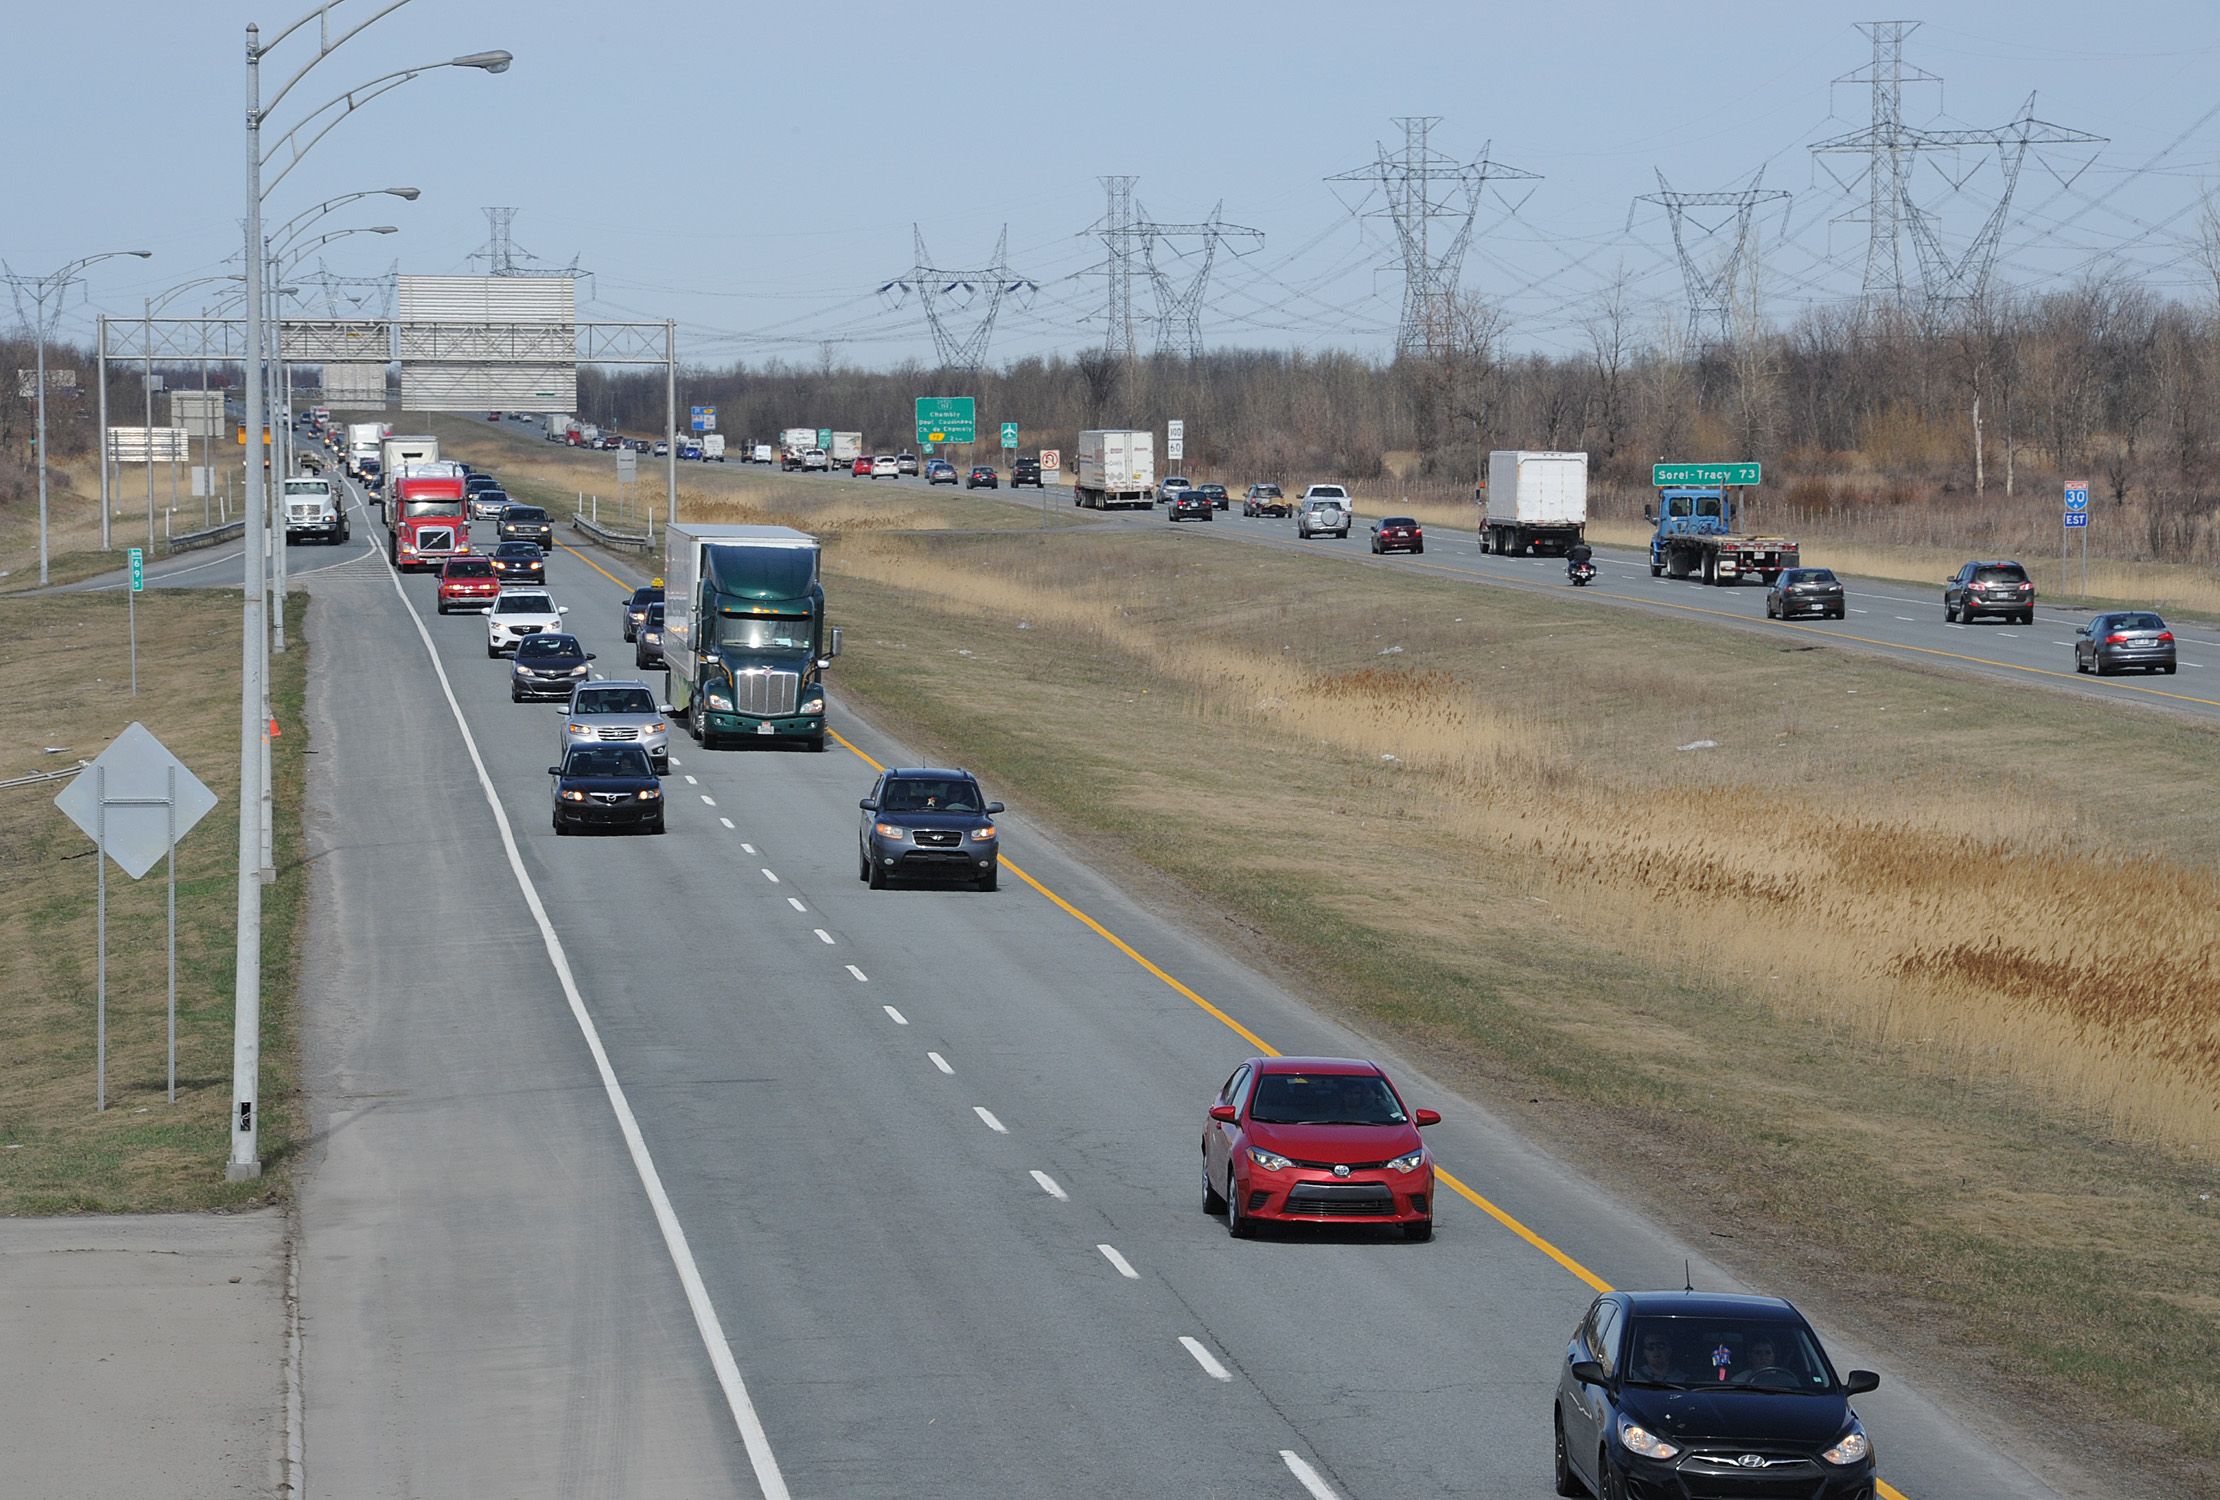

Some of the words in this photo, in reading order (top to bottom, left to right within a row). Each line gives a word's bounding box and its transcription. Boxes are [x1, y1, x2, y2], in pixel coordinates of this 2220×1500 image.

[1170, 427, 1182, 436] 100
[1170, 443, 1181, 452] 60
[1658, 469, 1731, 481] Sorel-Tracy
[1738, 469, 1755, 479] 73
[2067, 491, 2085, 503] 30
[2066, 515, 2085, 524] EST
